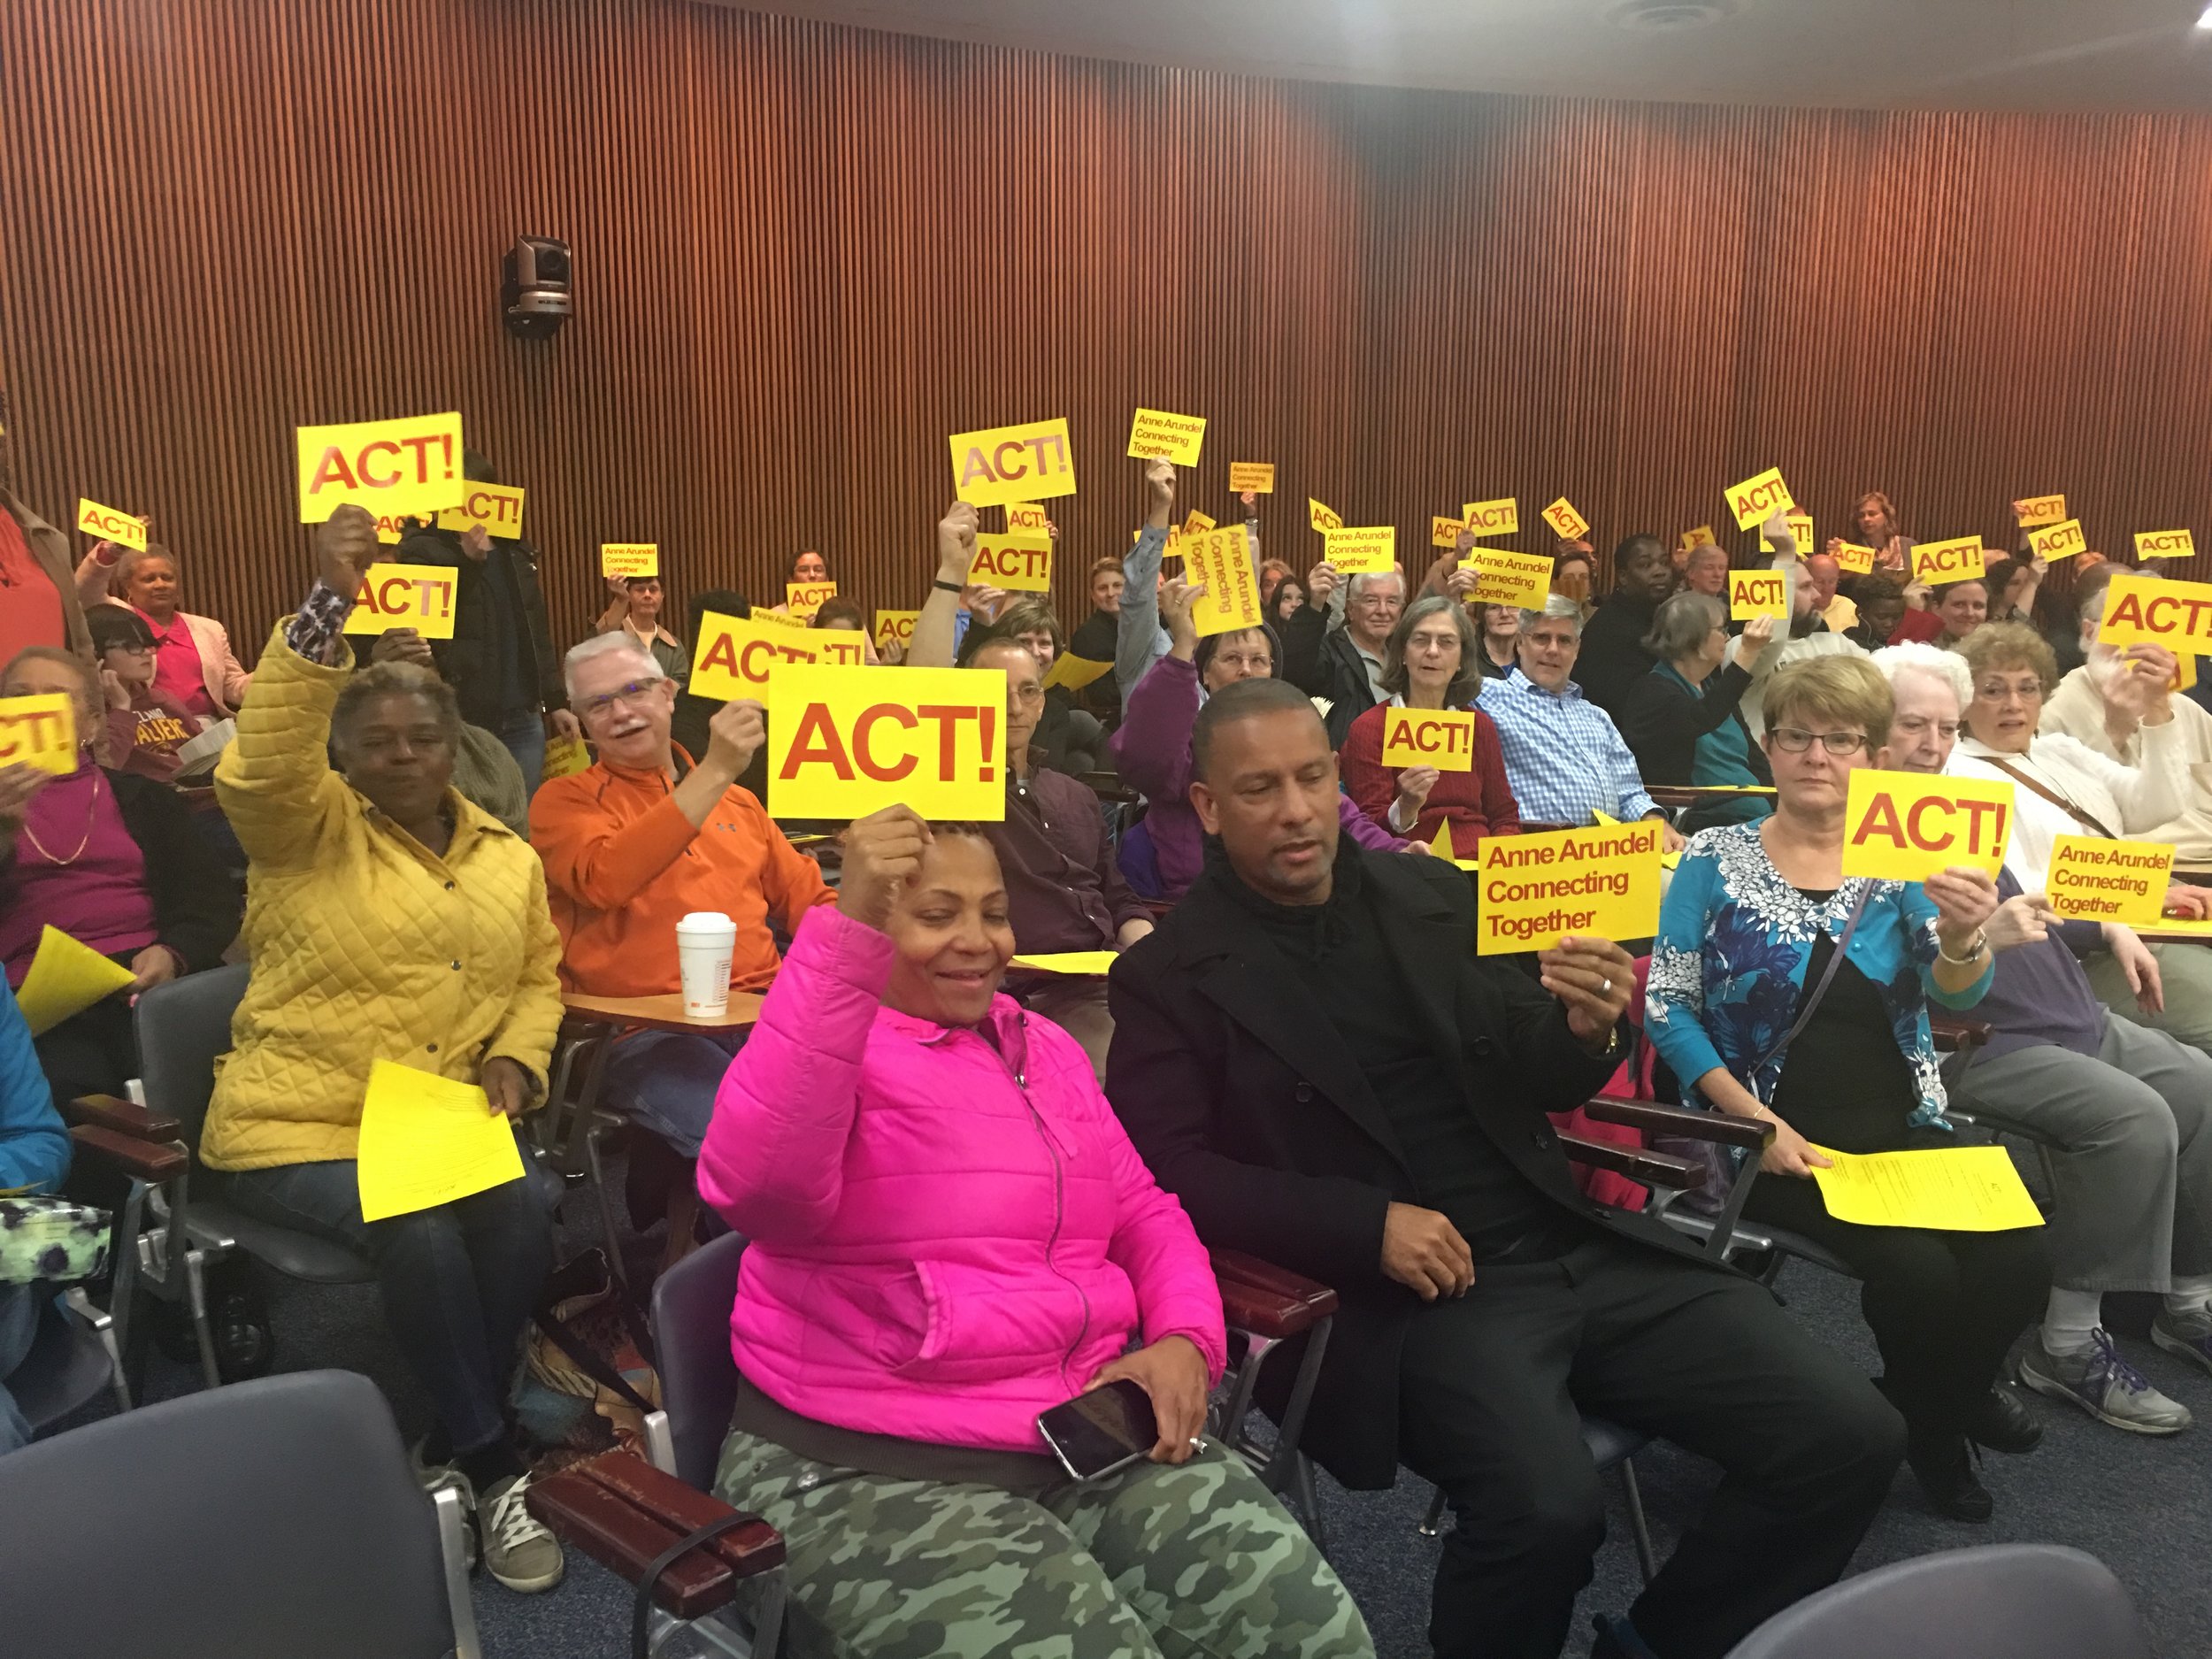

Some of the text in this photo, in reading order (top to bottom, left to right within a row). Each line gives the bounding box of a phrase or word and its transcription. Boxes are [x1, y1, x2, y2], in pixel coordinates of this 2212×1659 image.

[1138, 414, 1202, 434] Anne Arundel
[1133, 442, 1174, 457] Together
[1135, 428, 1189, 448] Connecting
[309, 433, 454, 495] ACT!
[961, 434, 1067, 488] ACT!
[1738, 478, 1787, 519] ACT!
[2020, 500, 2064, 519] ACT!
[83, 511, 143, 543] ACT!
[1009, 511, 1046, 527] ACT!
[1313, 508, 1344, 530] ACT
[1434, 522, 1463, 539] ACT
[1468, 506, 1516, 530] ACT!
[1328, 531, 1392, 542] Anne Arundel
[2037, 526, 2082, 554] ACT!
[2141, 534, 2190, 552] ACT!
[1327, 544, 1381, 555] Connecting
[1832, 549, 1870, 567] ACT!
[1916, 543, 1981, 575] ACT!
[971, 547, 1048, 579] ACT!
[1210, 534, 1233, 614] Connecting
[1328, 557, 1370, 569] Together
[1473, 554, 1550, 574] Anne Arundel
[1479, 572, 1536, 590] onnecting
[1732, 580, 1784, 606] ACT!
[356, 578, 452, 618] ACT!
[1474, 587, 1518, 601] ogether
[779, 703, 995, 782] ACT!
[1386, 719, 1471, 754] ACT!
[1851, 792, 2007, 857] ACT!
[1486, 830, 1655, 870] Anne Arundel
[2058, 845, 2170, 870] Anne Arundel
[1487, 871, 1629, 903] Connecting
[2055, 869, 2149, 896] Connecting
[2051, 892, 2123, 915] Together
[1486, 910, 1596, 940] Together
